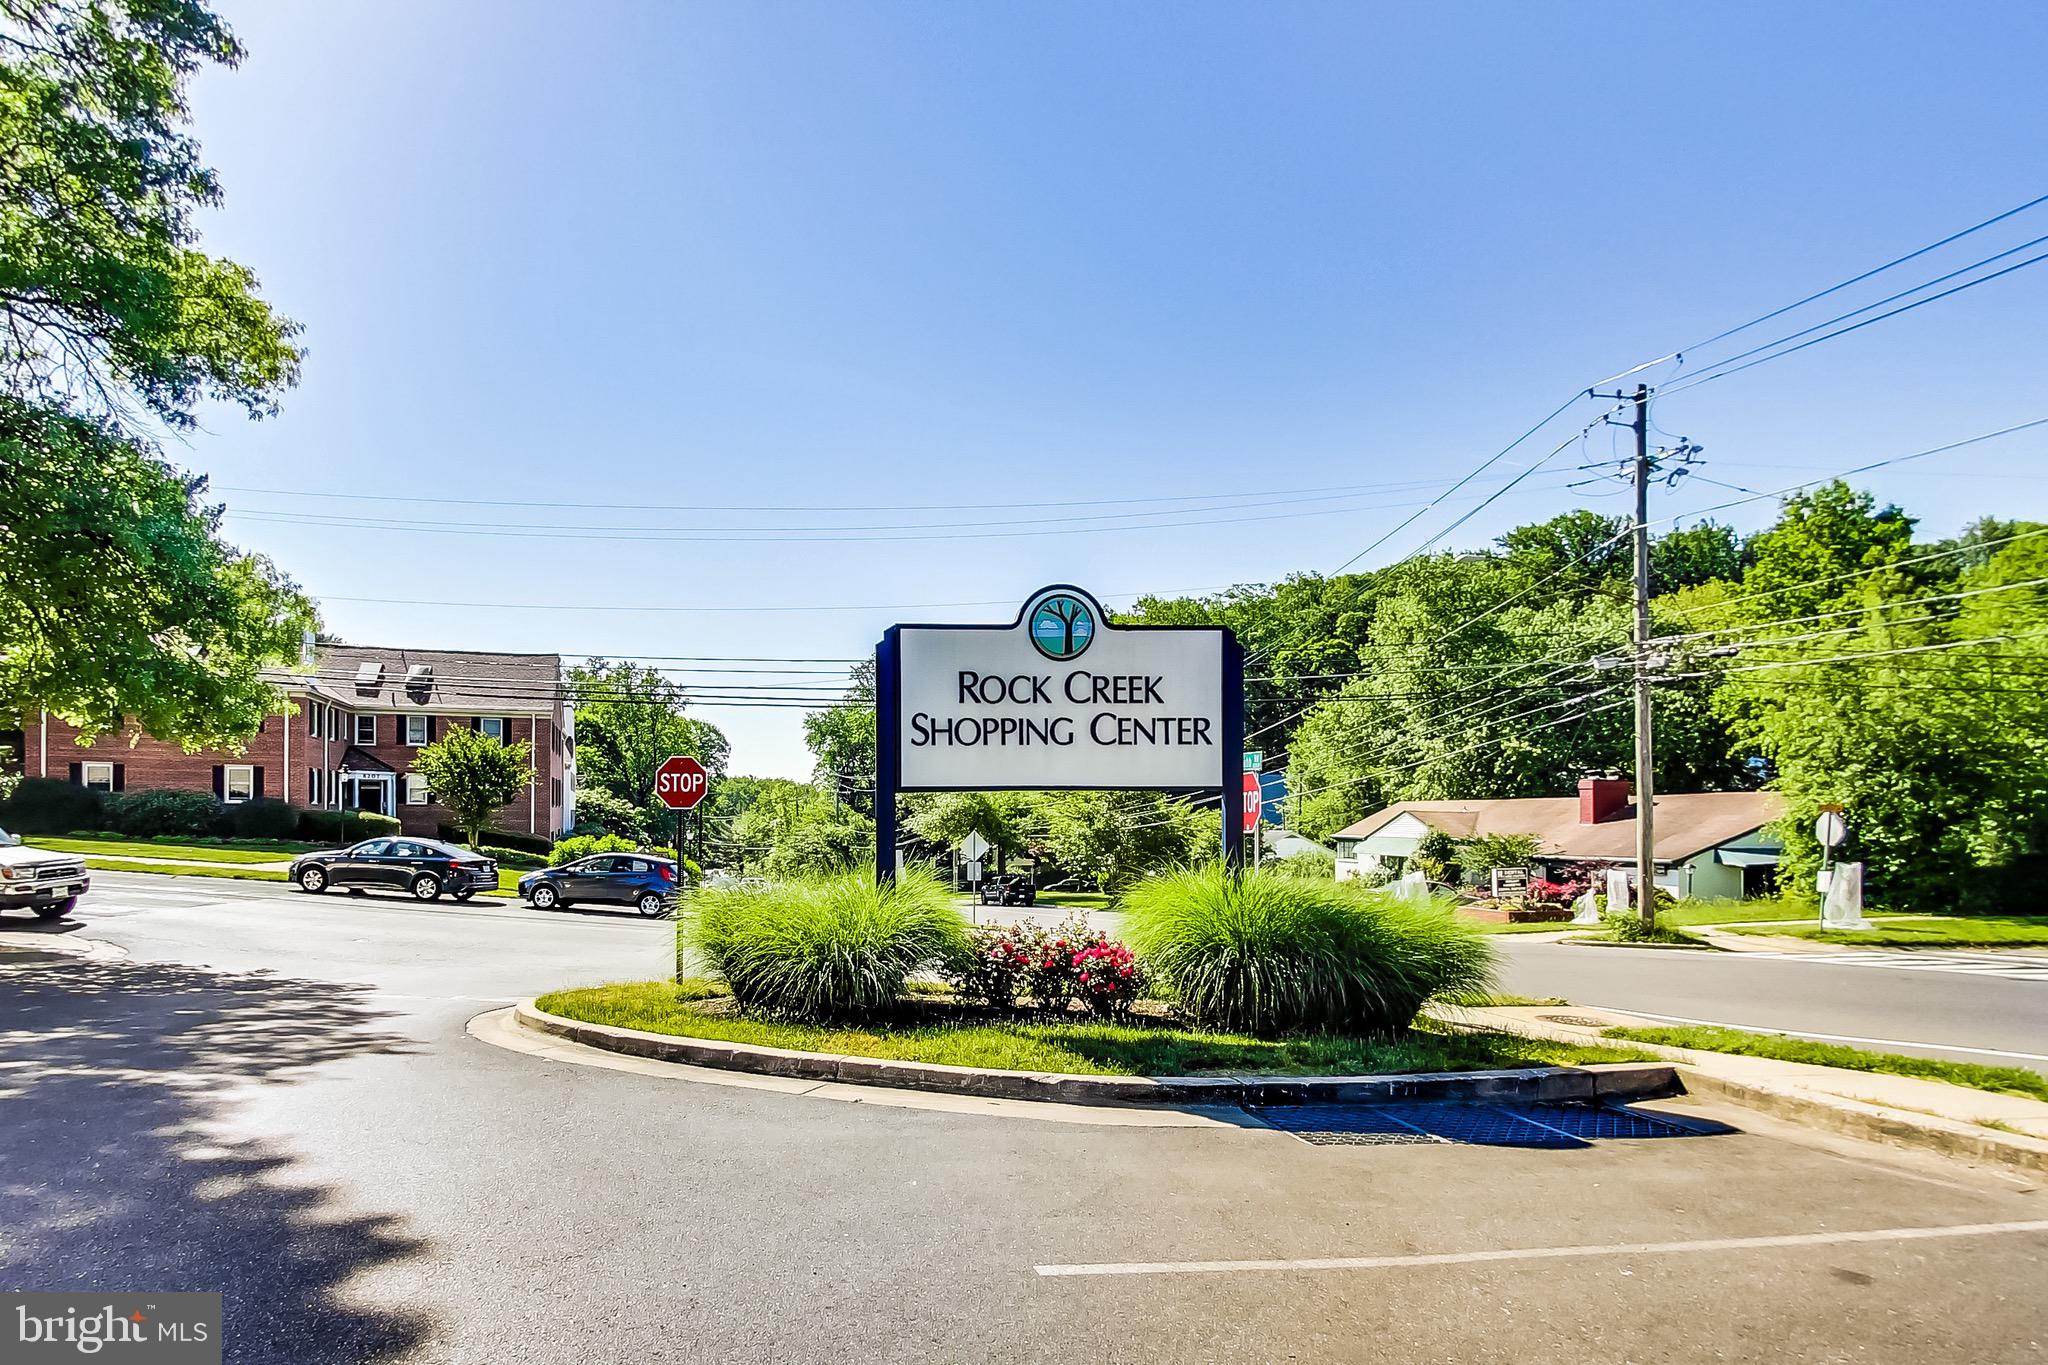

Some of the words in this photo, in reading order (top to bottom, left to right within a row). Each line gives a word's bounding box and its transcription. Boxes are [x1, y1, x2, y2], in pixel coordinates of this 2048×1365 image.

[958, 670, 1052, 704] ROCK
[1064, 670, 1164, 704] CREEK
[910, 712, 1074, 746] SHOPPING
[1089, 712, 1213, 746] CENTER
[659, 772, 704, 793] STOP
[1243, 790, 1258, 813] TOP
